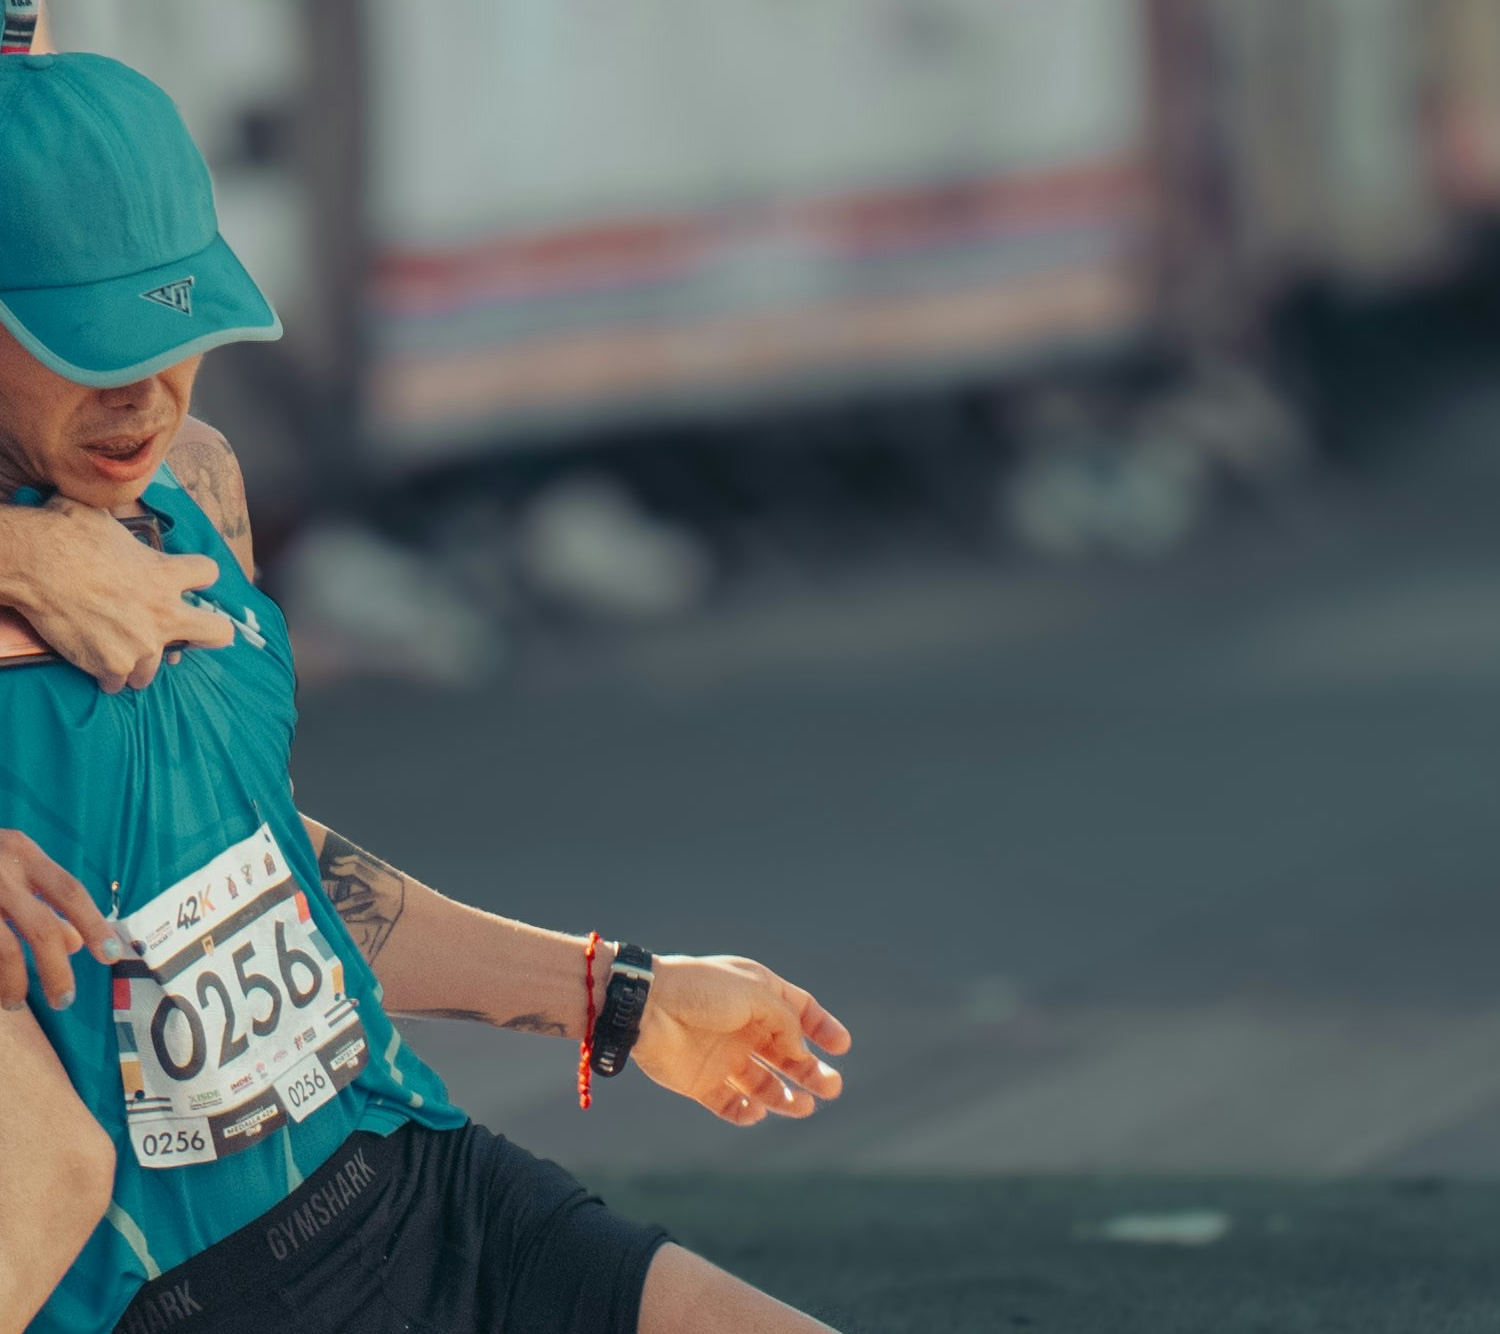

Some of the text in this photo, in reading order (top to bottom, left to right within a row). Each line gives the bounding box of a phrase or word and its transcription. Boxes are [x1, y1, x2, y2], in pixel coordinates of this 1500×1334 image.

[176, 883, 216, 930] 42K
[150, 919, 323, 1082] 0256
[287, 1067, 326, 1108] 0256
[143, 1130, 206, 1157] 0256
[266, 1147, 377, 1262] GYMSHARK
